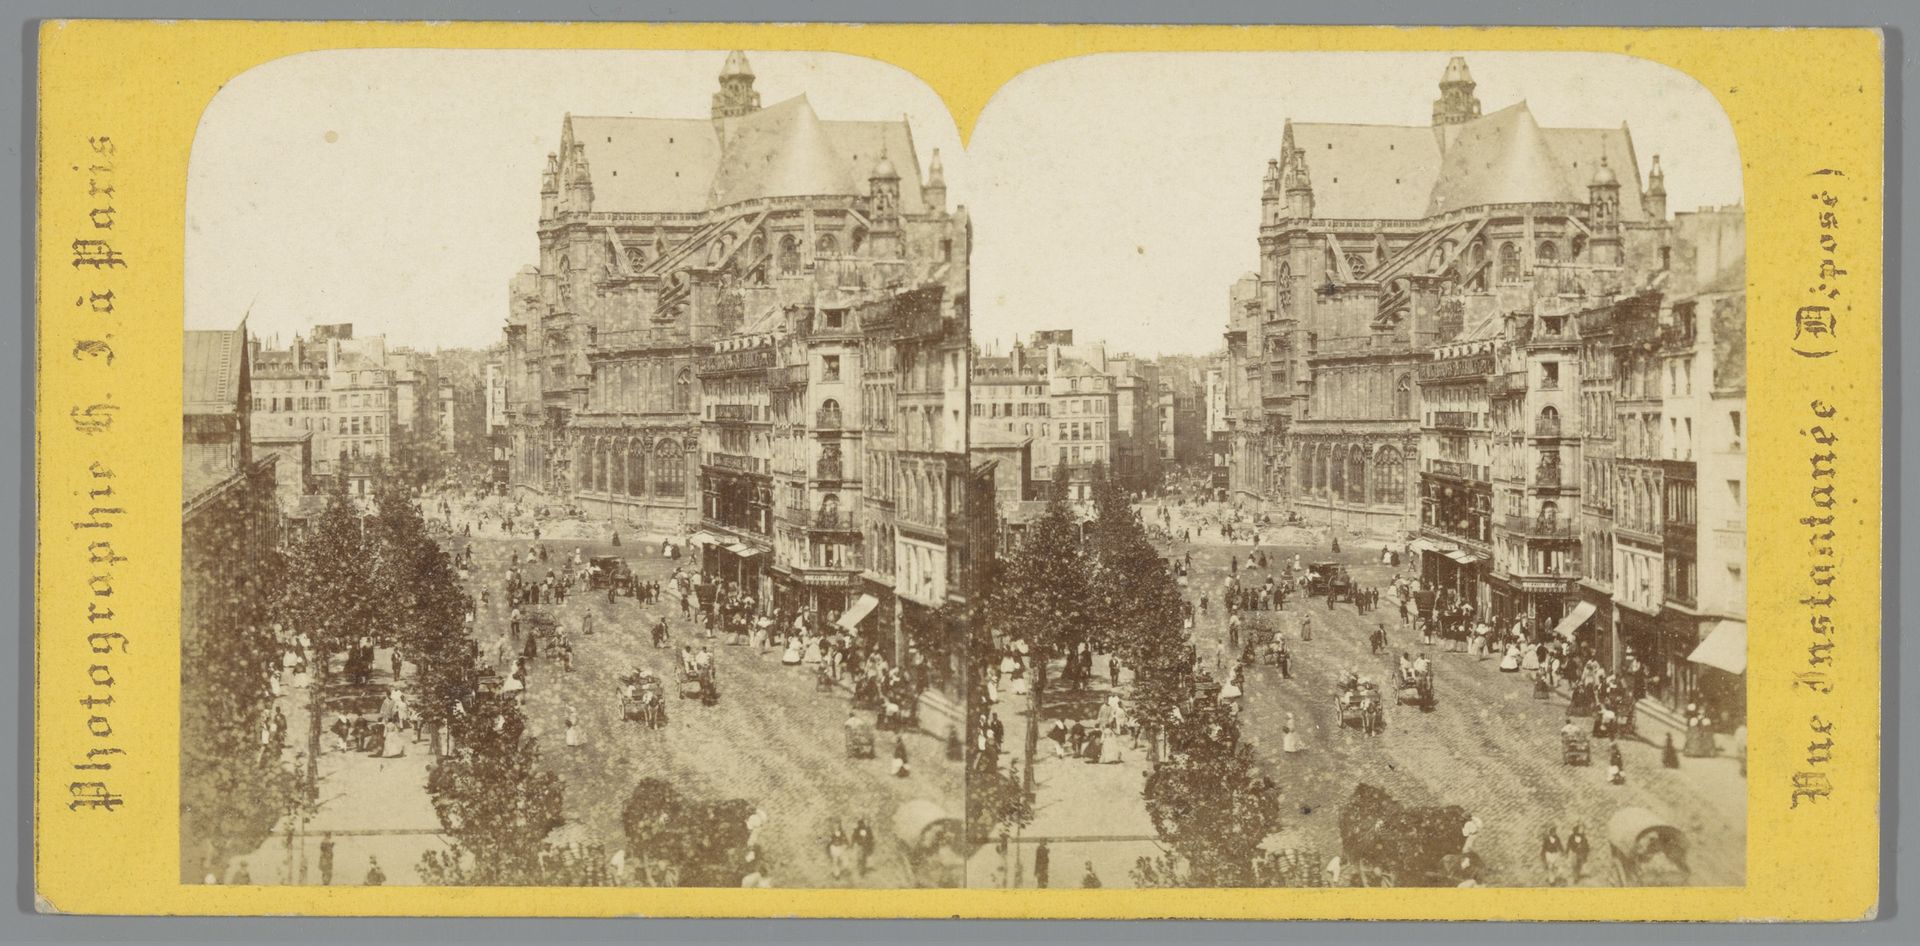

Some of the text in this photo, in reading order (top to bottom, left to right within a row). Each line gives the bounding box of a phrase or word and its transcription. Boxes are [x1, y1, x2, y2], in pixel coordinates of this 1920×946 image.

[72, 136, 128, 270] Paris
[76, 289, 117, 313] à
[1792, 399, 1837, 694] Instantanée
[66, 460, 129, 811] Photographie
[1790, 714, 1834, 809] Vue
